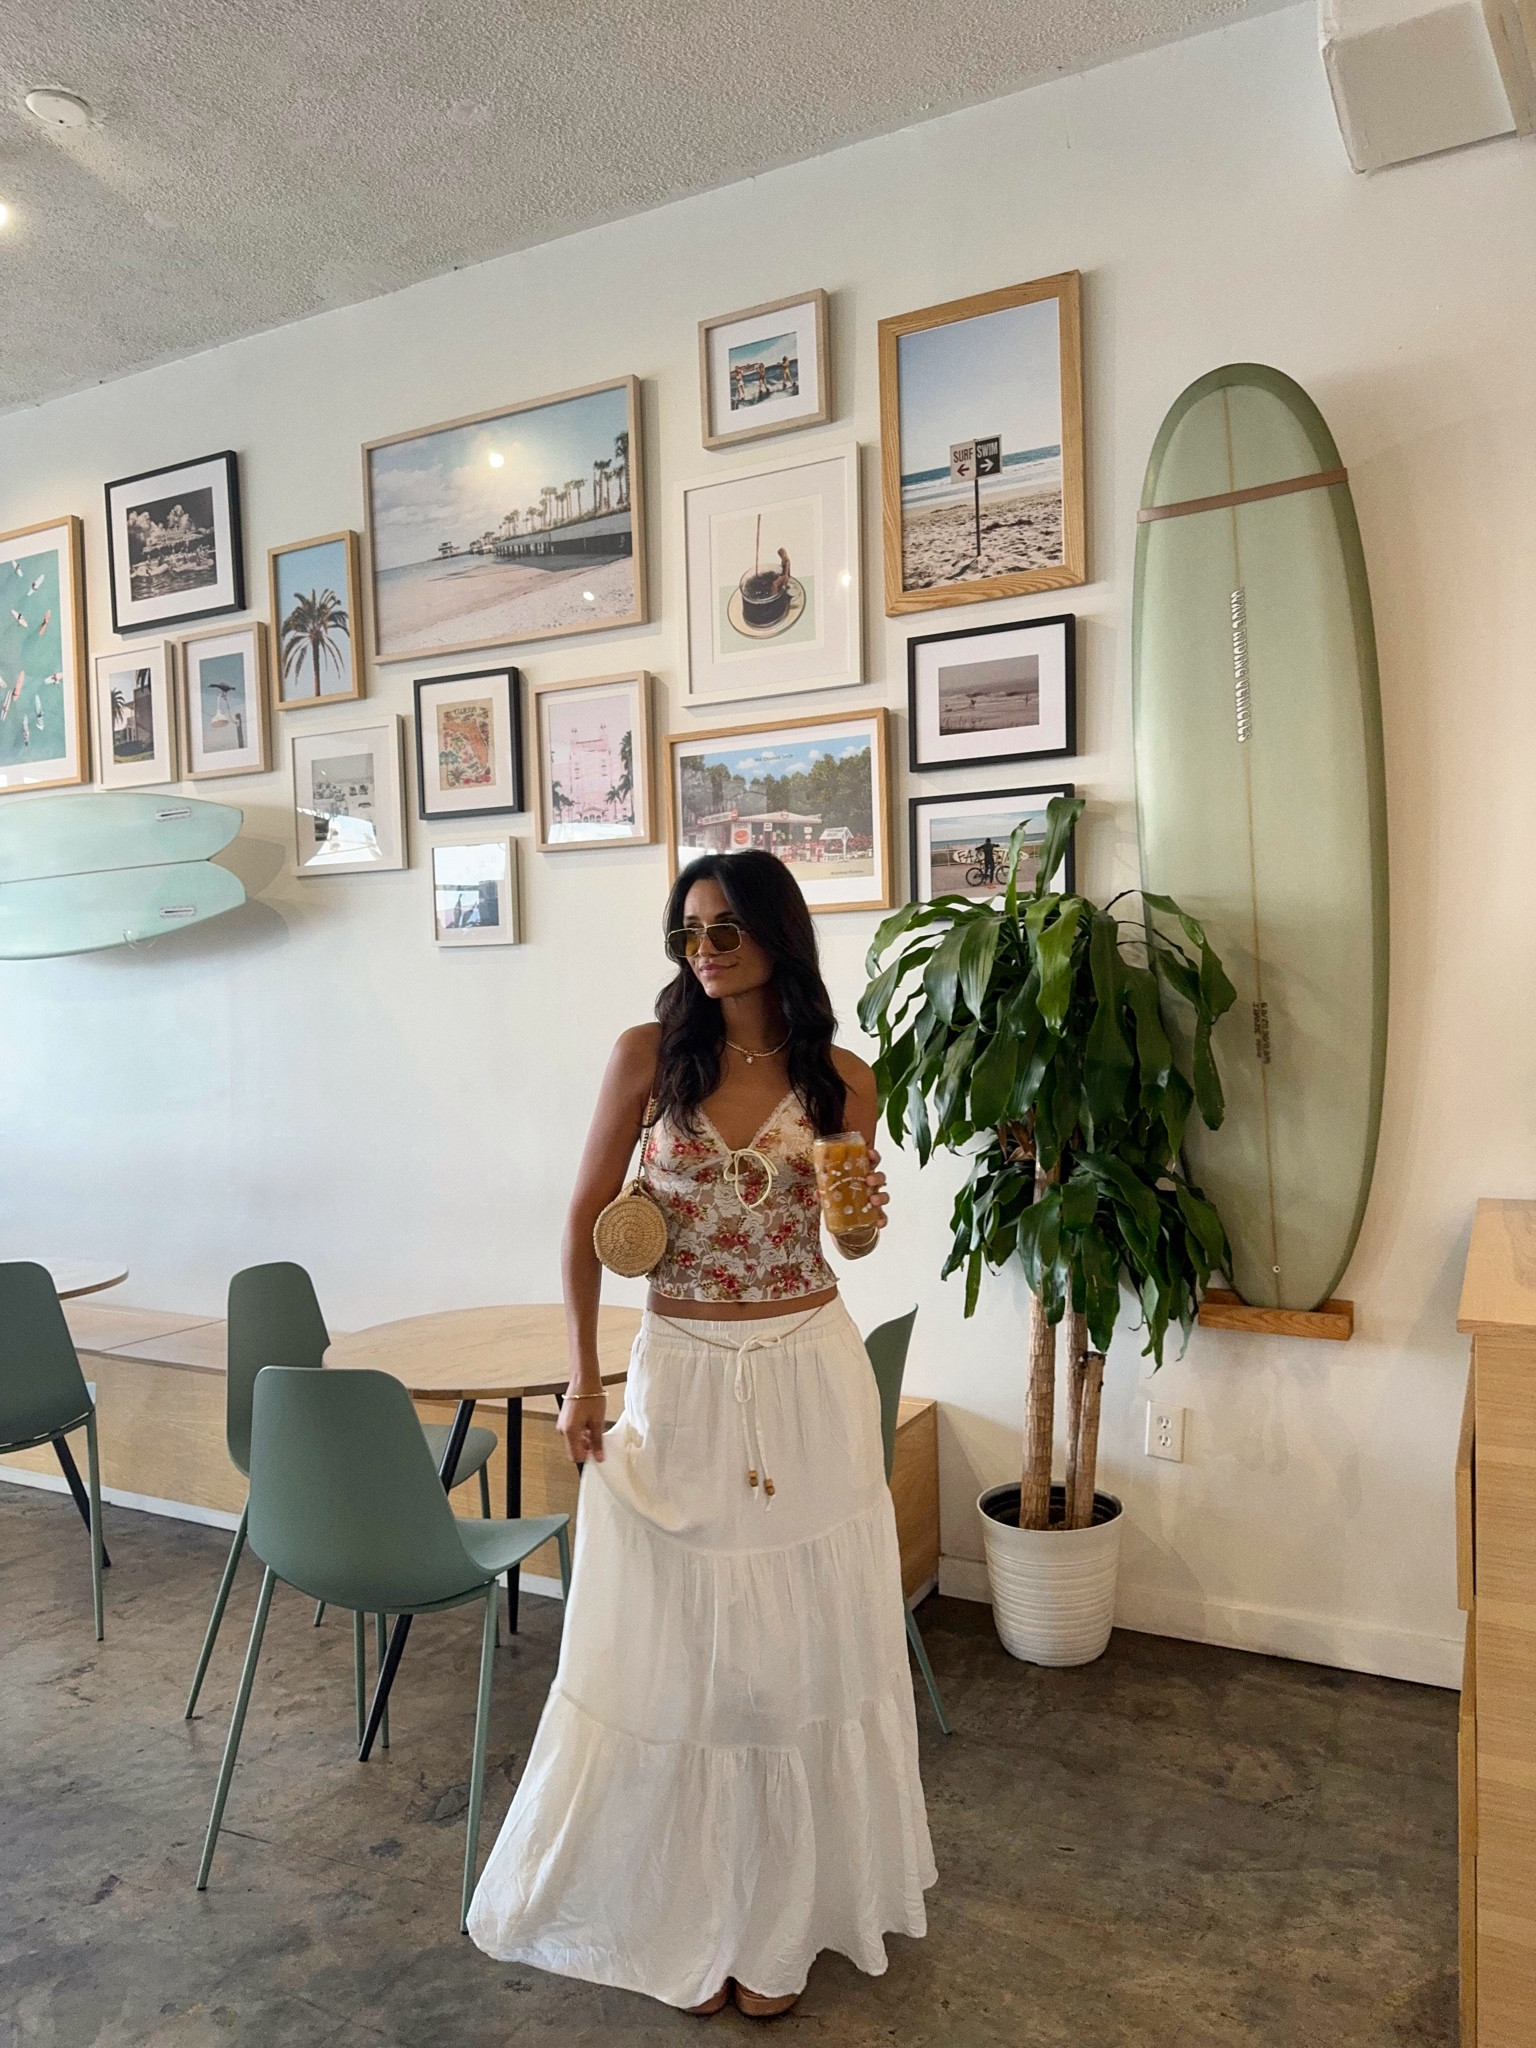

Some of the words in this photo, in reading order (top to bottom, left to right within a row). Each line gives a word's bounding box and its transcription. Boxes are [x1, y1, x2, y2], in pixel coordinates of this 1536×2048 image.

[953, 447, 973, 463] SURF
[977, 441, 998, 458] SWIM
[1231, 587, 1246, 629] WAVE
[1233, 629, 1249, 679] RIDING
[1236, 679, 1252, 743] VEHICLES
